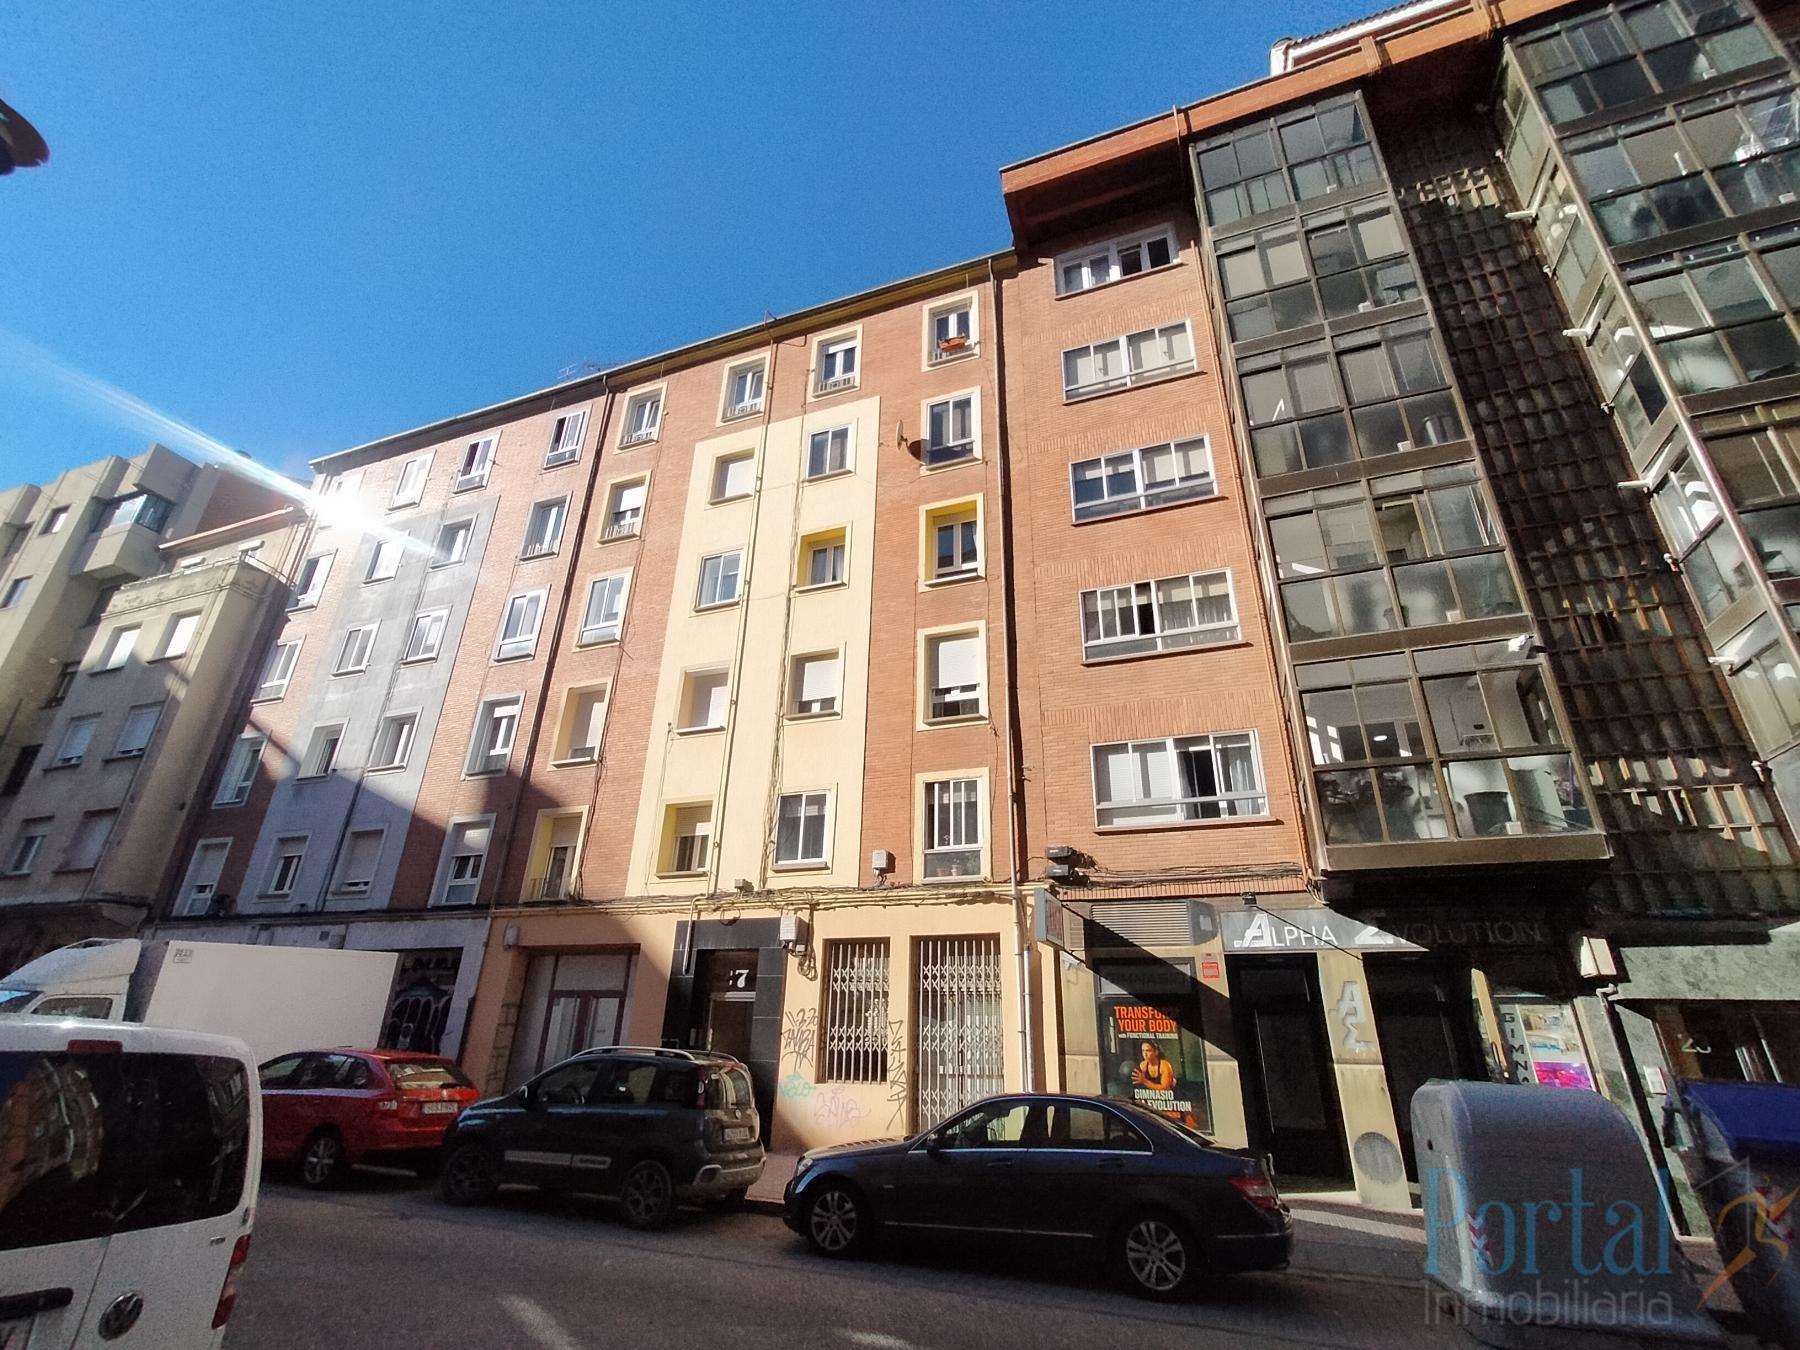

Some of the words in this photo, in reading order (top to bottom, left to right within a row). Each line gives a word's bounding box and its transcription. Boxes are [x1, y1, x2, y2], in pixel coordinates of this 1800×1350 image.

[1117, 1020, 1147, 1032] YOUR
[1148, 1020, 1178, 1032] BODY
[1134, 1088, 1175, 1101] GIMNASIO
